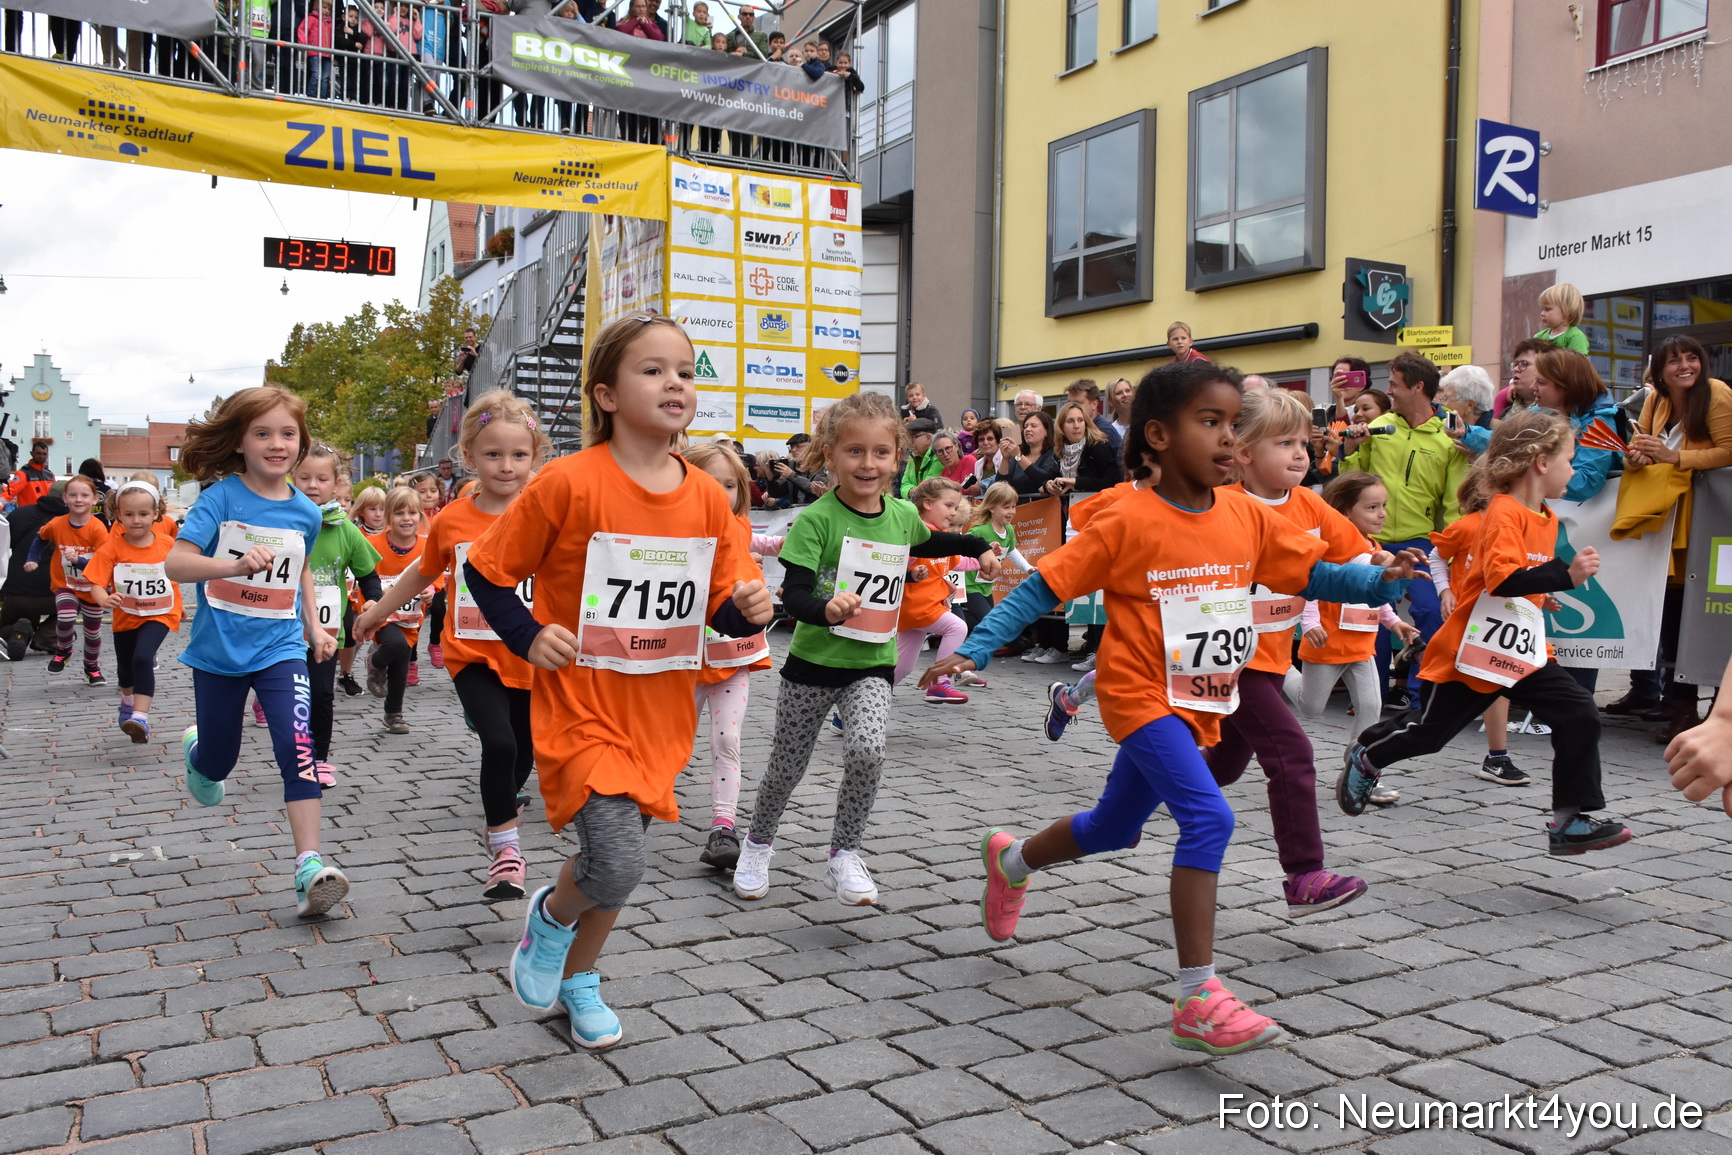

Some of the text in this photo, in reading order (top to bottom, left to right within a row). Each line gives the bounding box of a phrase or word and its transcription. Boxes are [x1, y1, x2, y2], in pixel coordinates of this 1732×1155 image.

[513, 34, 630, 78] BOCK
[511, 58, 635, 88] inspired by smart concepts
[649, 63, 828, 108] OFFICE INDUSTRY LOUNGE
[680, 88, 804, 121] www.bockonline.de
[25, 108, 195, 144] Neumarkter Stadtlauf
[284, 121, 436, 182] ZIEL
[513, 171, 640, 192] Neumarkter Stadtlauf
[704, 193, 731, 204] energie
[744, 230, 782, 246] swn
[1538, 225, 1653, 261] Unterer Markt 15
[776, 276, 796, 285] CODE
[776, 283, 800, 293] CLINIC
[1376, 282, 1398, 315] G2
[689, 317, 734, 329] VARIOTEC
[1406, 328, 1452, 338] Startnummern-
[1415, 336, 1442, 344] ausgabe
[1429, 351, 1463, 361] Toiletten
[775, 377, 804, 385] energie
[833, 370, 849, 378] MINI
[750, 406, 799, 418] Neumarkter Tagblatt
[1017, 518, 1045, 529] Partner
[1016, 527, 1048, 537] Umsetzung
[254, 535, 284, 546] BOCK
[644, 549, 689, 563] BOCK
[1146, 562, 1232, 583] Neumarkter
[123, 578, 167, 596] 7153
[1149, 580, 1220, 601] Stadtlauf
[240, 589, 269, 603] Kajsa
[606, 577, 696, 621] 7150
[586, 611, 596, 619] B1
[1270, 605, 1292, 616] Lena
[630, 635, 667, 650] Emma
[1482, 616, 1537, 661] 7034
[736, 641, 755, 653] Frida
[1596, 645, 1624, 659] GmbH
[1489, 655, 1525, 676] Patricia
[293, 673, 318, 783] AWESOME
